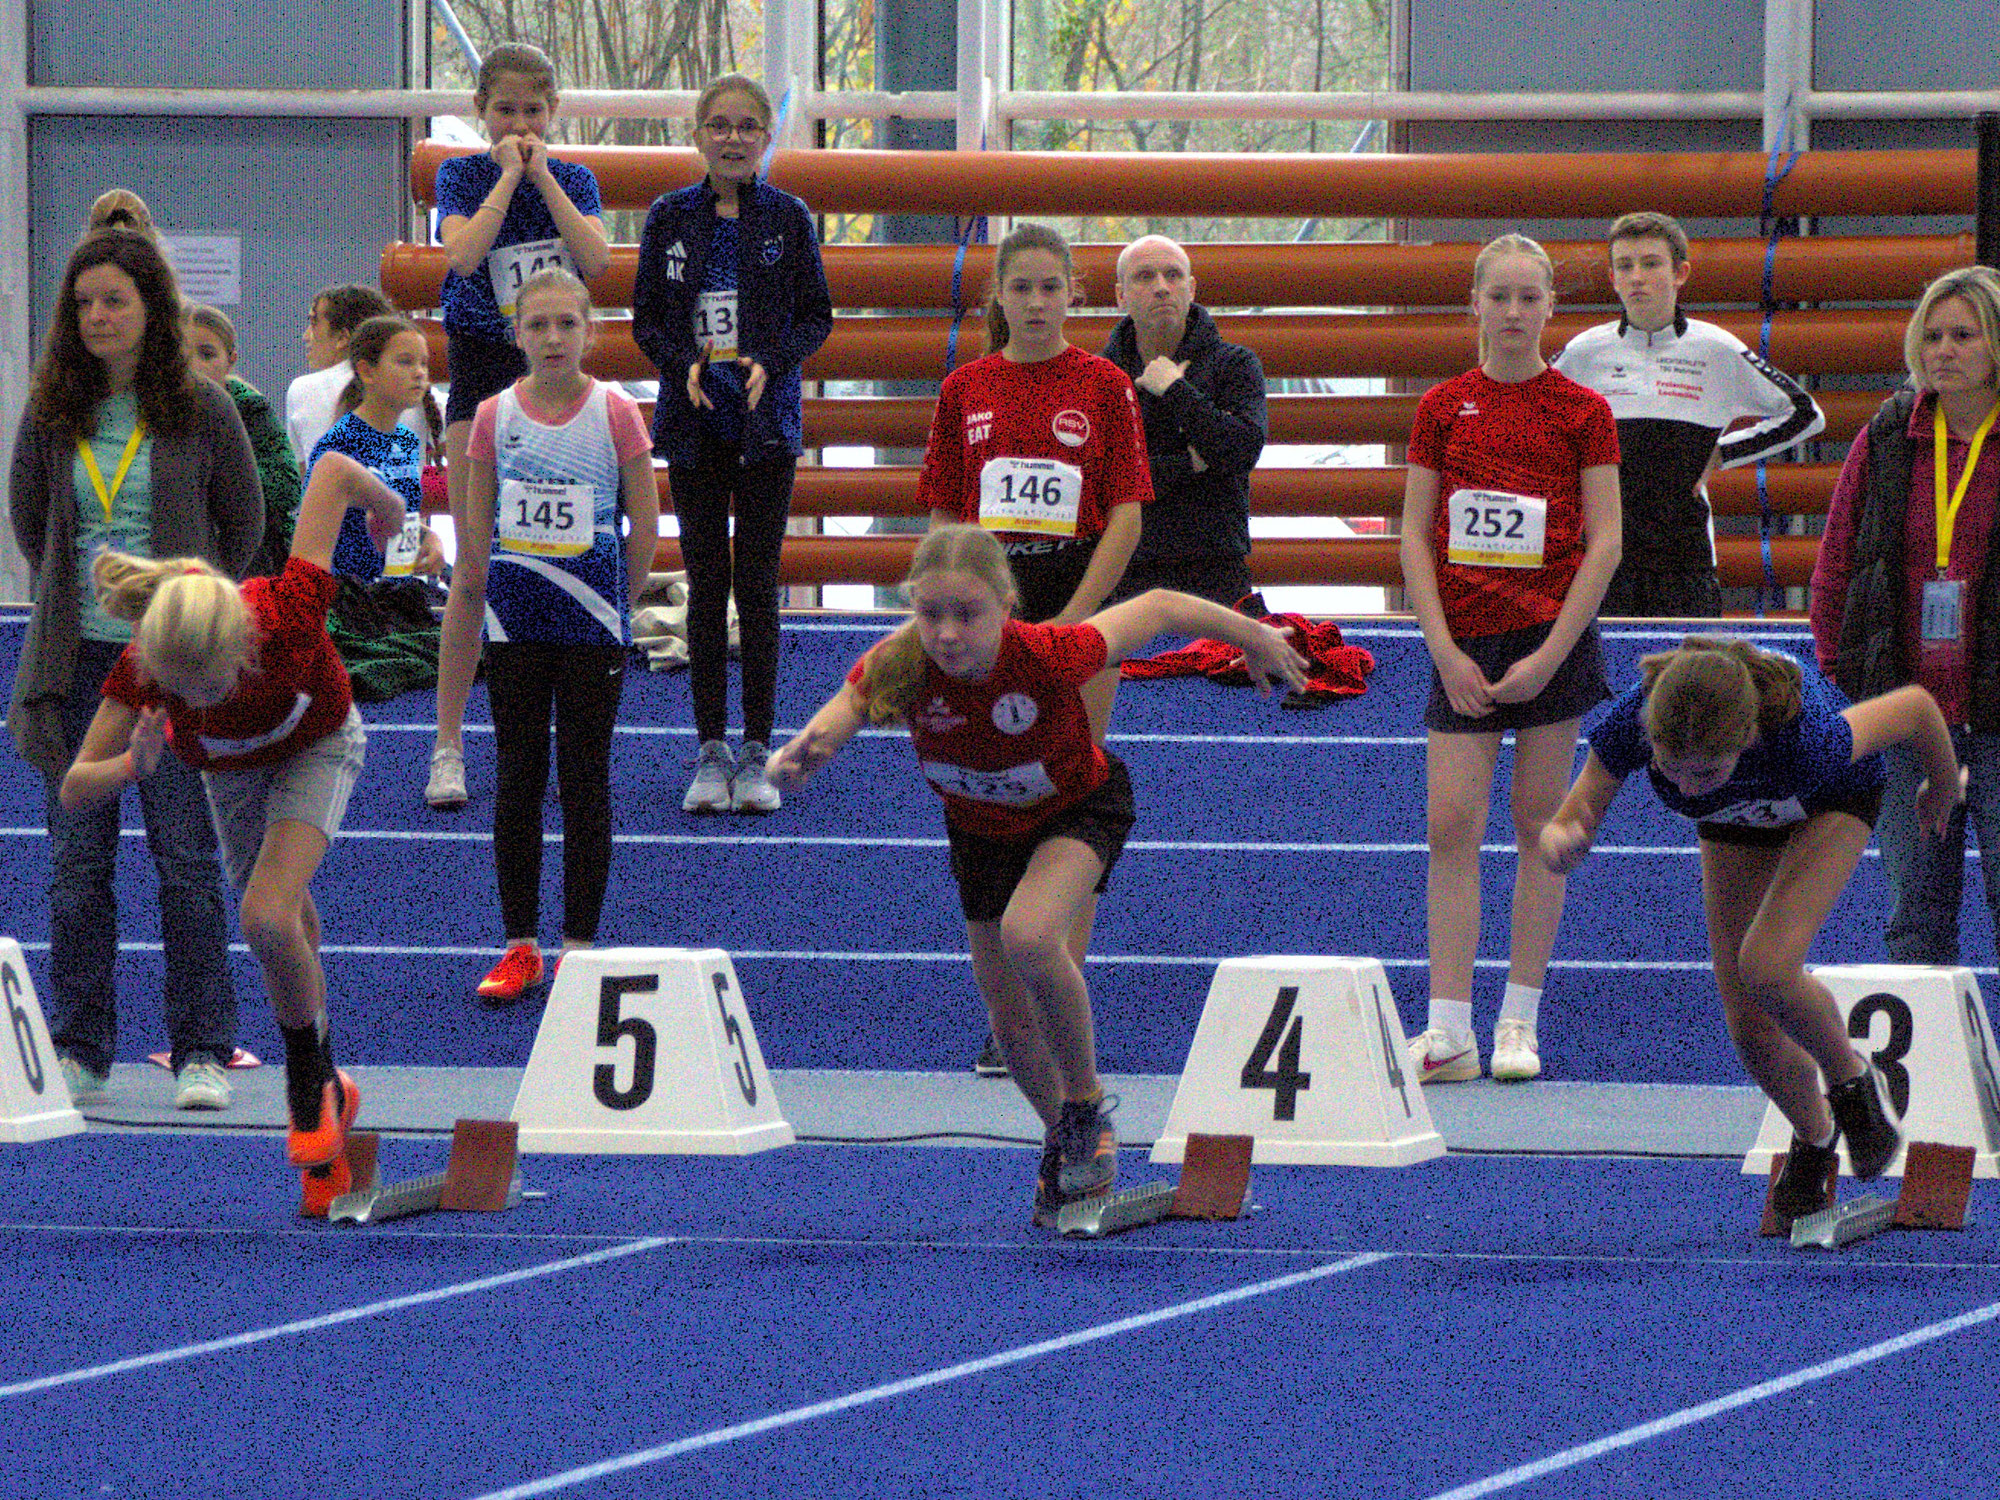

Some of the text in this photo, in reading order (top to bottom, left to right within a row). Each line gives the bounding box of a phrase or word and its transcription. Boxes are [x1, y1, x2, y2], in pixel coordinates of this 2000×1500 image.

[666, 260, 685, 282] AK
[967, 411, 993, 425] JAKO
[1058, 417, 1086, 430] RSV
[968, 424, 992, 445] EAT
[1021, 461, 1055, 470] hummel
[1000, 474, 1062, 506] 146
[516, 499, 575, 530] 145
[1464, 507, 1525, 538] 252
[2, 961, 44, 1095] 6
[593, 974, 659, 1111] 5
[712, 972, 757, 1107] 5
[1240, 986, 1311, 1121] 4
[1372, 984, 1412, 1118] 4
[1848, 992, 1914, 1123] 3
